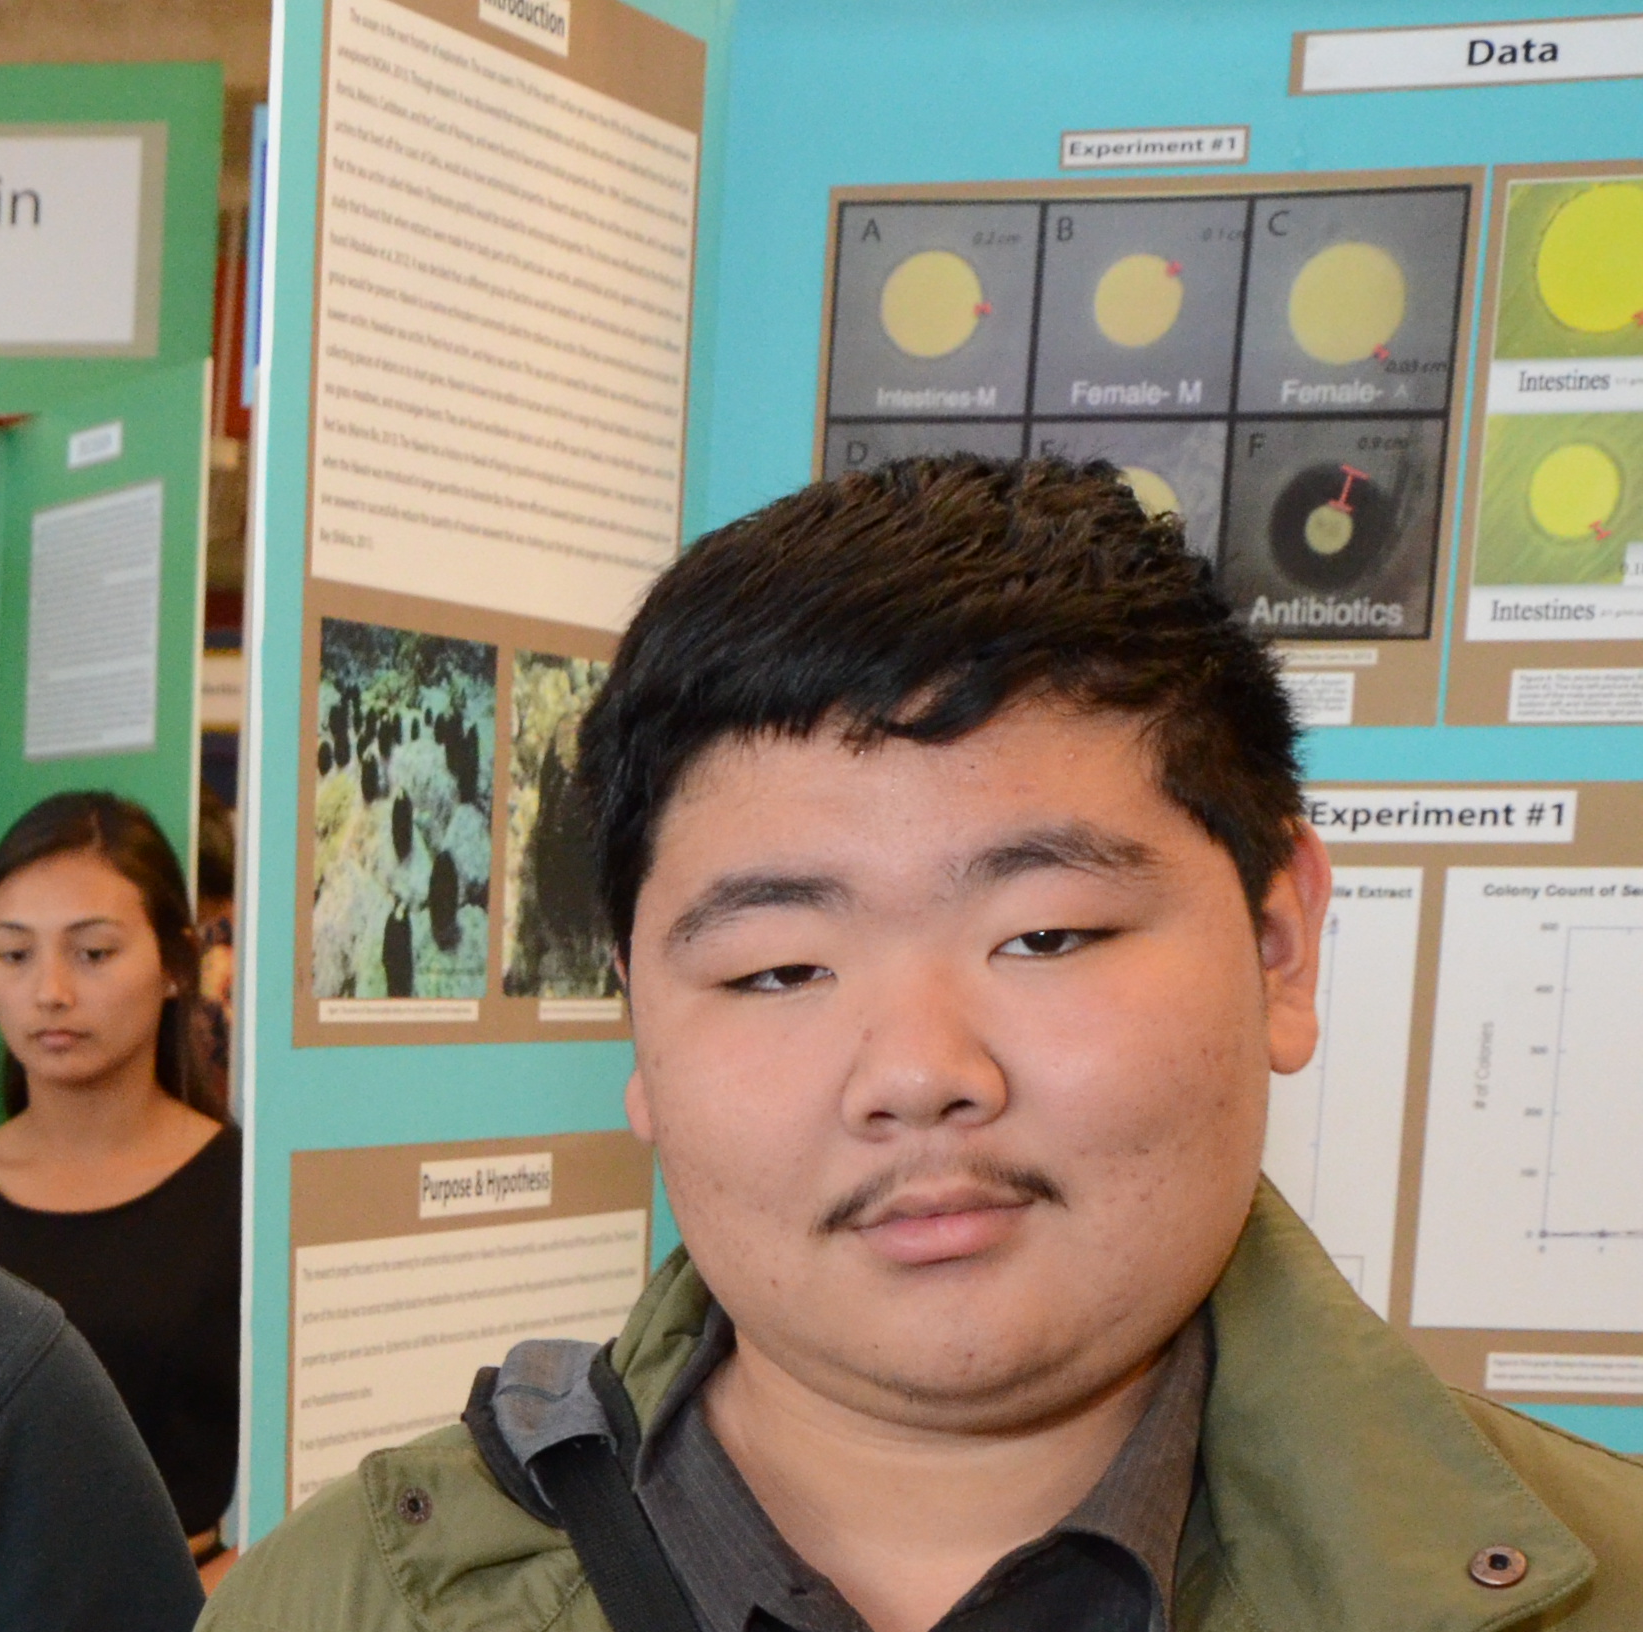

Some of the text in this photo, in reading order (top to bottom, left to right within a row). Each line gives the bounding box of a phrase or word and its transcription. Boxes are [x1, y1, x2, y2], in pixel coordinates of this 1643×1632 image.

[1466, 38, 1560, 68] Data
[1069, 136, 1238, 162] Experiment #1
[861, 218, 881, 242] A
[1057, 217, 1073, 241] B
[1268, 210, 1289, 237] C
[1070, 378, 1203, 406] Female- M
[1281, 379, 1383, 403] Female-
[1518, 369, 1610, 393] Intestines
[1250, 594, 1404, 629] Antibiotics
[1490, 598, 1596, 622] Intestines
[1310, 800, 1565, 836] Experiment #1
[1358, 885, 1414, 899] Extract
[1483, 883, 1616, 900] Colony Count of
[421, 1164, 551, 1207] Purpose & Hypothesis
